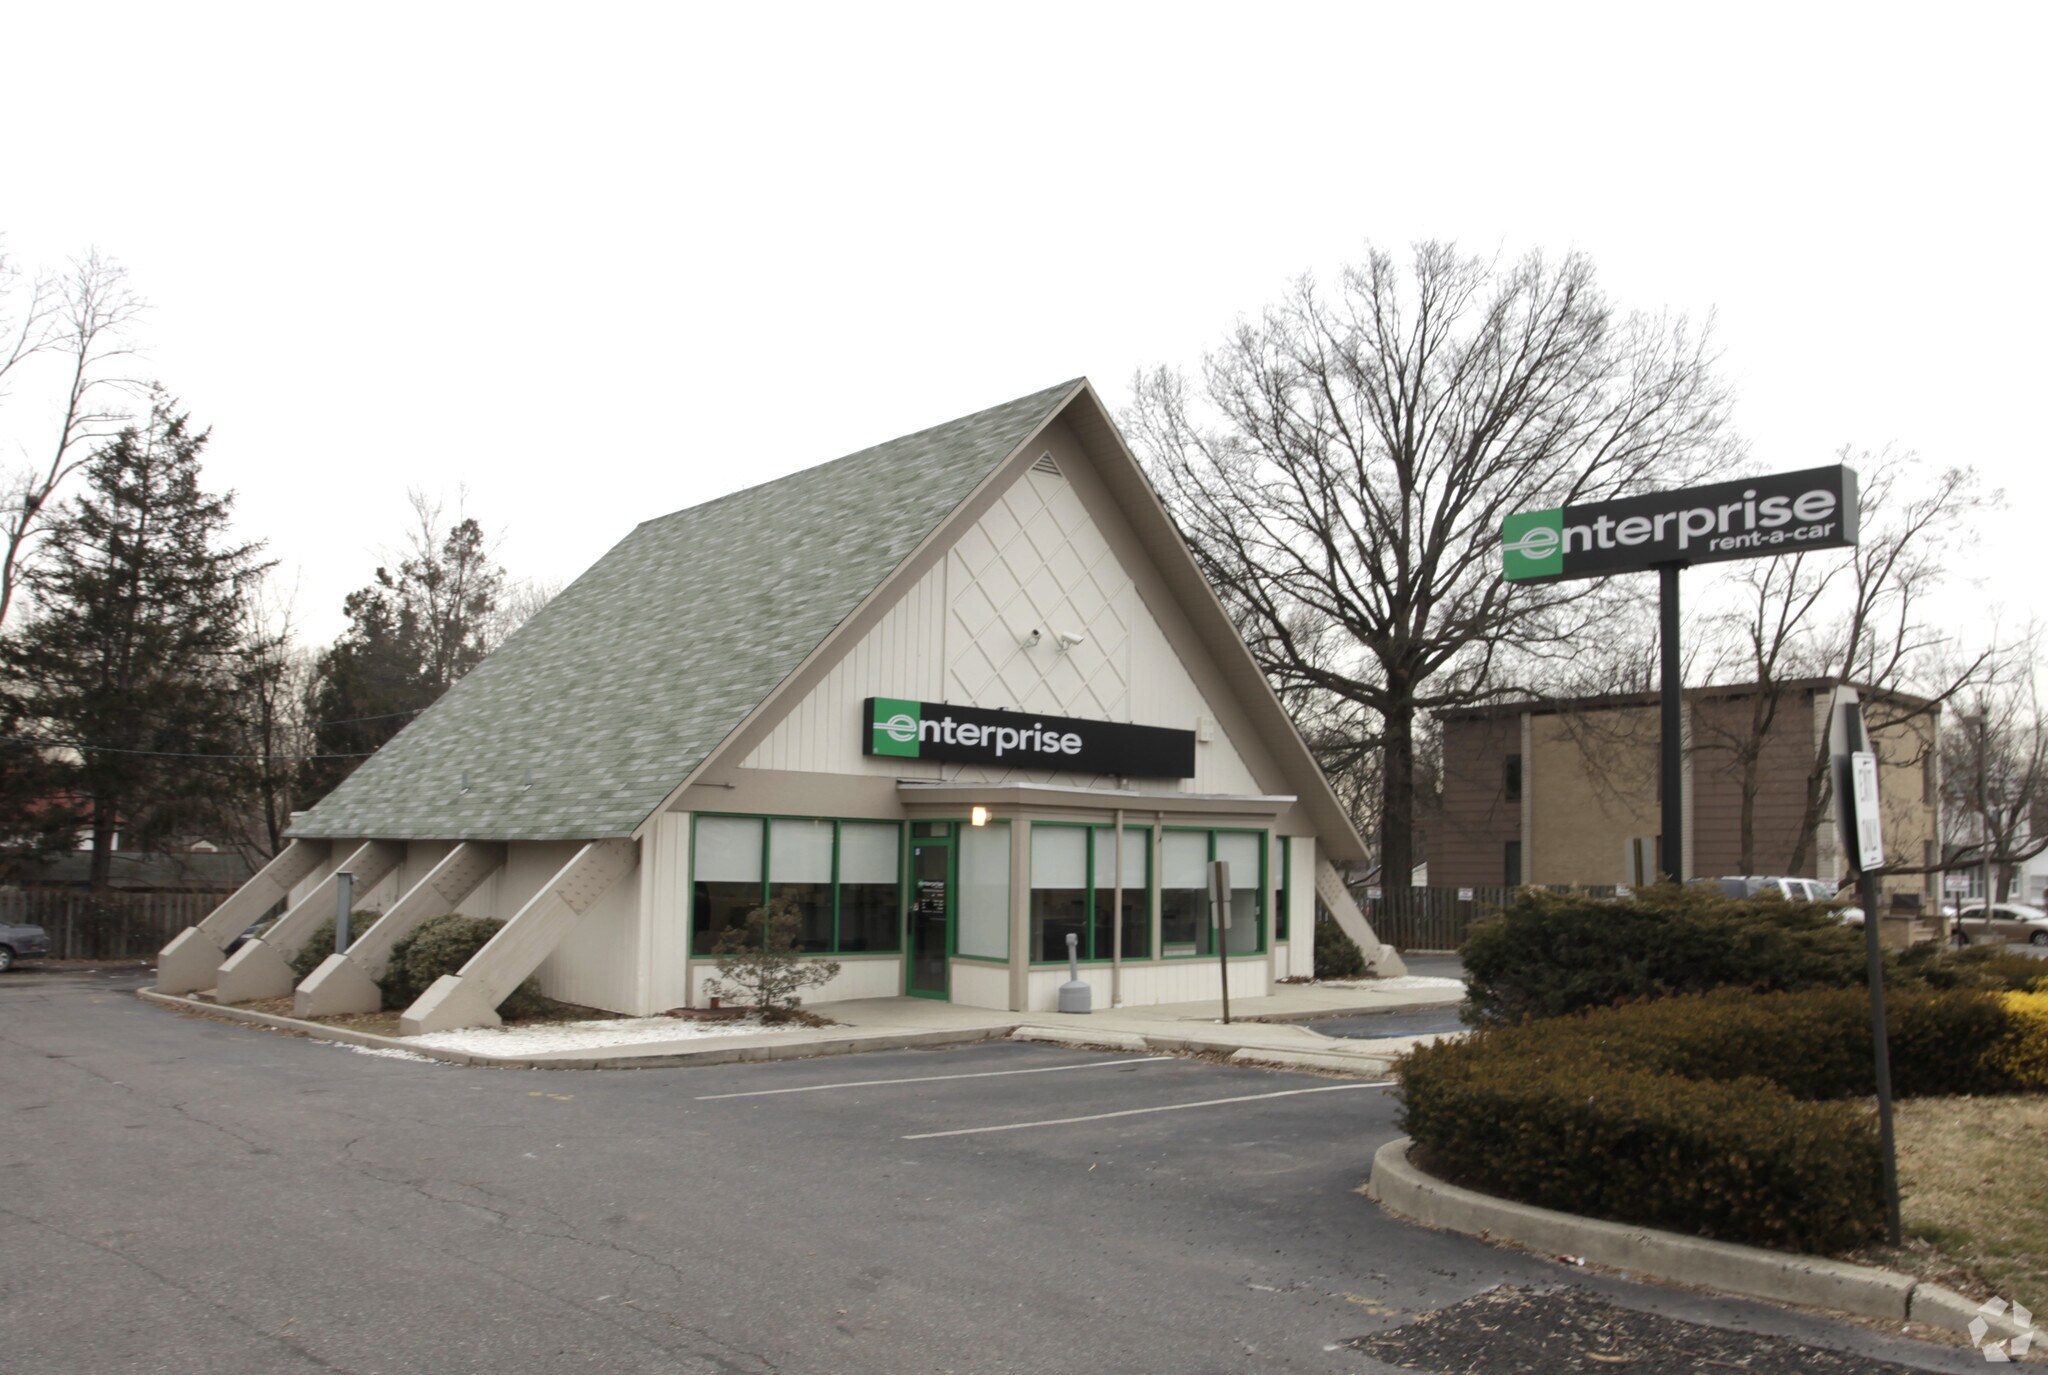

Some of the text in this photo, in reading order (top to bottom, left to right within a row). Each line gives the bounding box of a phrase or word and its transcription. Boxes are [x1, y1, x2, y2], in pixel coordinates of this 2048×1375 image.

[1504, 489, 1836, 559] enterprise
[1709, 521, 1836, 551] rent-a-car
[873, 714, 1083, 757] enterprise
